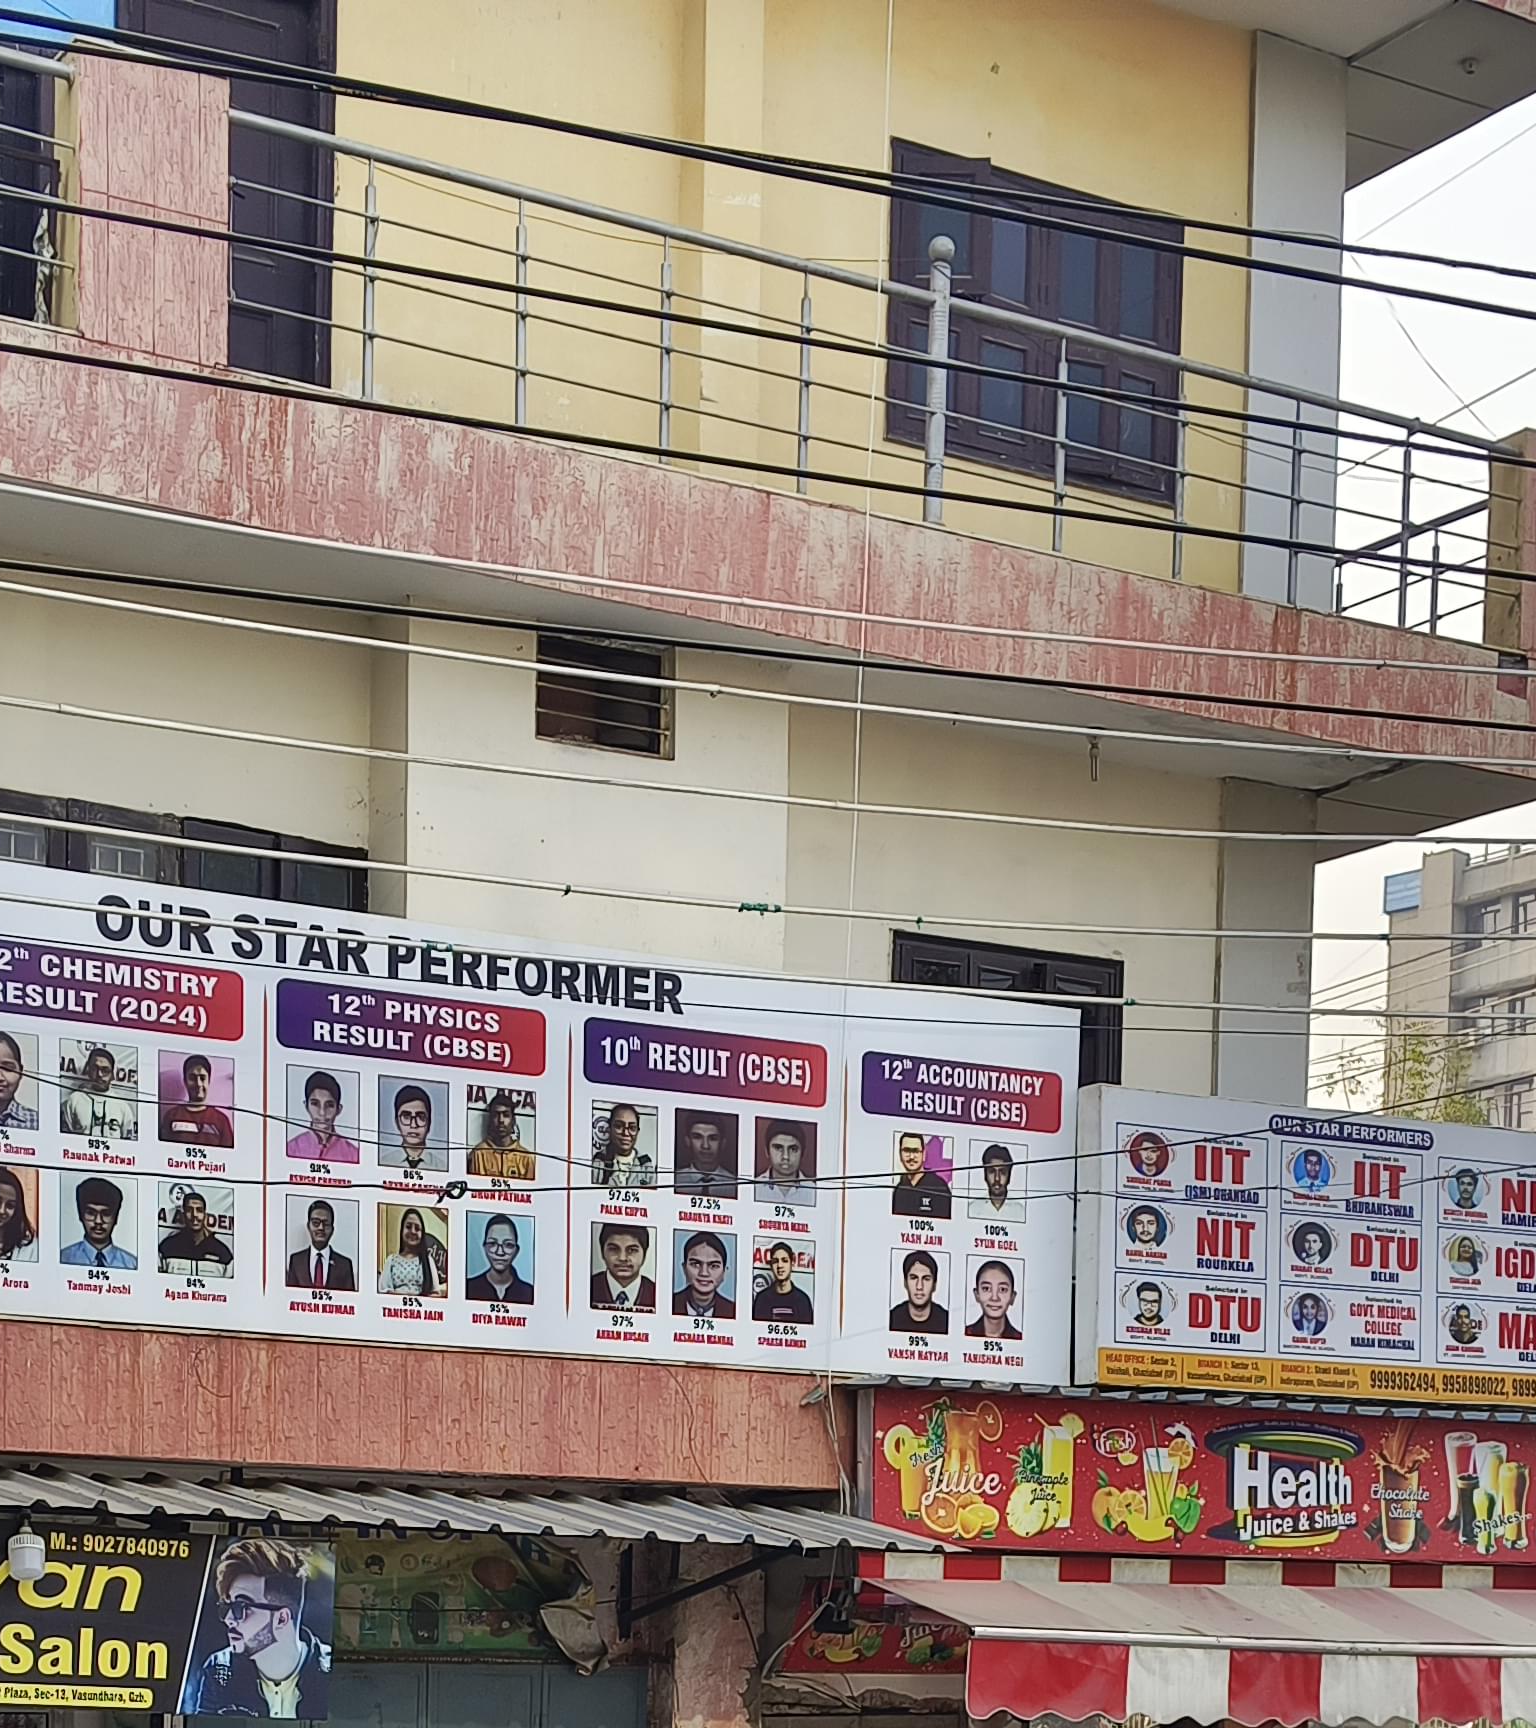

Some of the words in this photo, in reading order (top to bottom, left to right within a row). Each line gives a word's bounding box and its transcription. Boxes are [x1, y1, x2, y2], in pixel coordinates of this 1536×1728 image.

[95, 894, 214, 954] OUR
[231, 913, 369, 975] STAR
[387, 934, 684, 1015] PERFORMER
[40, 953, 219, 998] CHEMISTRY
[109, 995, 207, 1033] (2024)
[328, 992, 375, 1017] 12th
[384, 999, 501, 1033] PHYSICS
[313, 1020, 415, 1052] RESULT
[423, 1034, 512, 1068] (CBSE)
[601, 1035, 641, 1067] 10th
[648, 1041, 731, 1079] RESULT
[738, 1052, 811, 1093] (CBSE)
[881, 1058, 913, 1082] 12th
[917, 1063, 1044, 1097] ACCOUNTANCY
[901, 1090, 964, 1117] RESULT
[970, 1097, 1028, 1128] (CBSE)
[1272, 1117, 1301, 1134] OUR
[1304, 1121, 1341, 1138] STAR
[1343, 1123, 1432, 1148] PERFORMERS
[185, 1147, 207, 1159] 95%
[1194, 1144, 1251, 1185] IIT
[1354, 1160, 1406, 1200] IIT
[609, 1189, 640, 1203] 97.6%
[1184, 1184, 1212, 1200] (ISM)
[690, 1197, 721, 1210] 97.5%
[774, 1206, 795, 1218] 97%
[1345, 1200, 1414, 1218] BHUBANESWAR
[909, 1219, 934, 1232] 100%
[984, 1224, 1009, 1237] 100%
[1196, 1217, 1256, 1260] NIT
[1350, 1232, 1418, 1272] DTU
[1196, 1257, 1254, 1273] ROURKELA
[2, 1276, 29, 1290] Arora
[1370, 1271, 1399, 1283] DELHI
[66, 1280, 103, 1295] Tanmay
[106, 1283, 131, 1296] Joshi
[612, 1315, 634, 1328] 97%
[1188, 1292, 1262, 1333] DTU
[1377, 1305, 1416, 1321] MEDICAL
[693, 1318, 715, 1331] 97%
[767, 1324, 798, 1337] 96.6%
[1364, 1320, 1402, 1336] COLLEGE
[1210, 1332, 1241, 1345] DELHI
[921, 1463, 1002, 1506] Juice
[1017, 1469, 1070, 1487] Pineapple
[1233, 1442, 1353, 1511] Health
[1371, 1484, 1430, 1501] Chocolate
[1388, 1502, 1423, 1520] Shake
[1239, 1508, 1293, 1541] Juice
[1297, 1515, 1311, 1532] &
[1314, 1509, 1357, 1530] Shakes
[83, 1533, 190, 1559] 9027840976
[34, 1687, 69, 1702] Sec-13,
[71, 1689, 126, 1704] Vasundhara,
